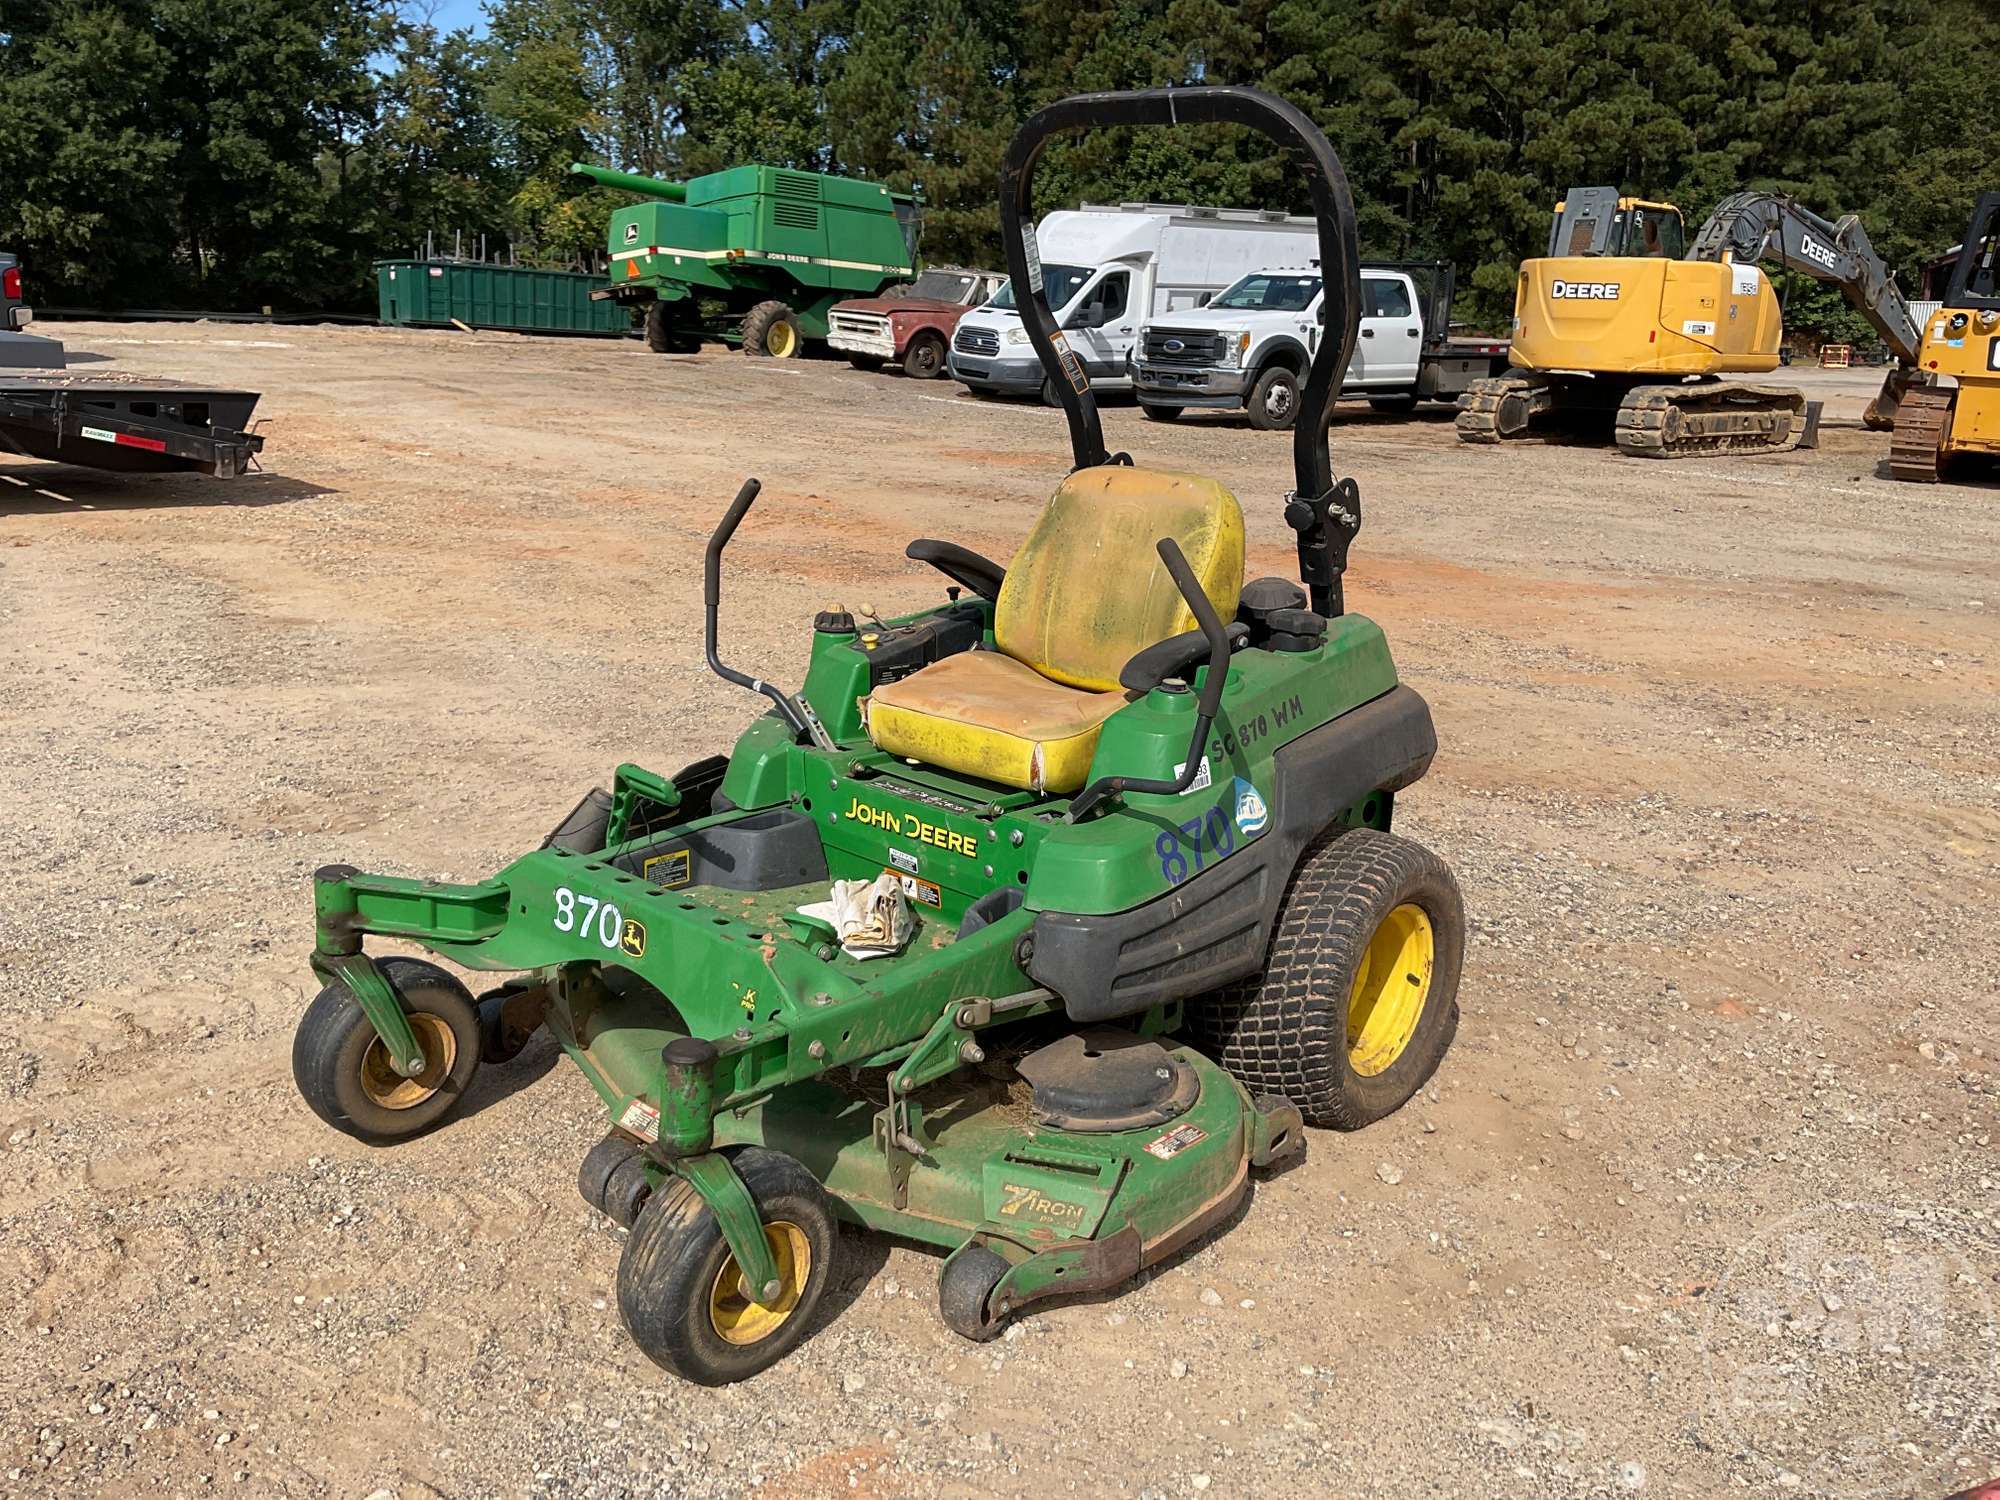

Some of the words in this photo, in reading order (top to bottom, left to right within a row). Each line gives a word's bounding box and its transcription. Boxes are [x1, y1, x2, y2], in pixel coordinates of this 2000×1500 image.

[767, 253, 786, 262] JOHN
[787, 254, 810, 263] DEERE
[1800, 234, 1837, 269] DEERE
[1552, 279, 1620, 300] DEERE
[1240, 717, 1268, 748] 870
[845, 798, 901, 835] JOHN
[904, 813, 979, 859] DEERE
[1154, 805, 1235, 886] 870
[553, 887, 622, 949] 870
